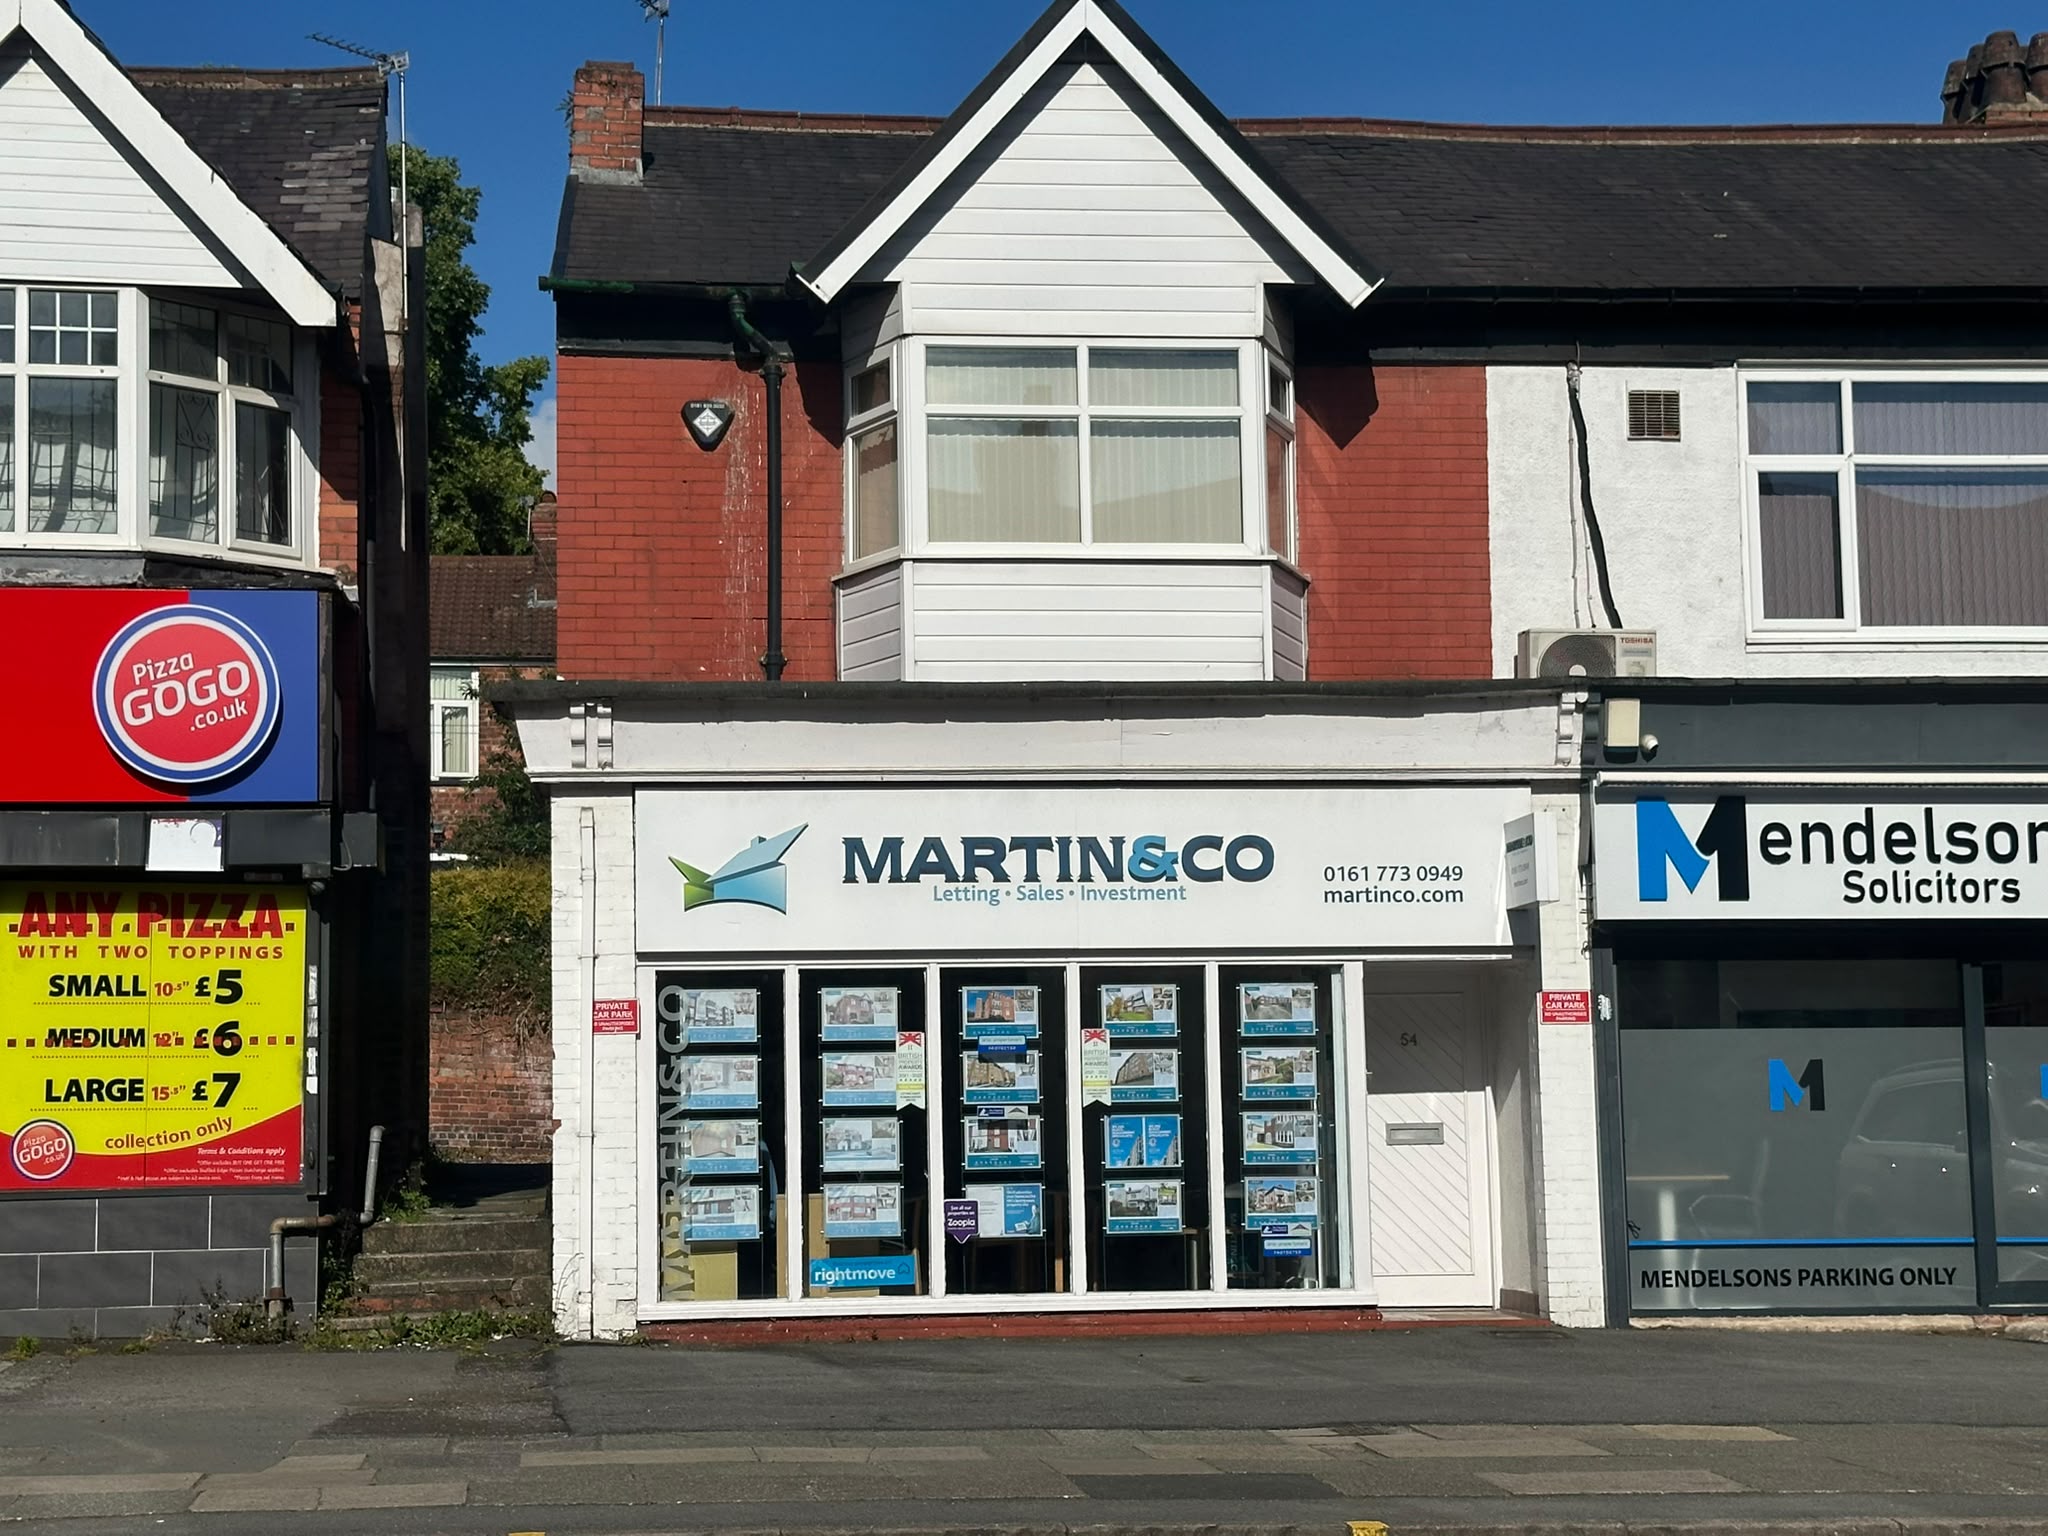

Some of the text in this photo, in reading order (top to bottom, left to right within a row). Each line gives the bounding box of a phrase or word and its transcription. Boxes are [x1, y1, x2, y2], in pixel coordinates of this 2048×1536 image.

[133, 652, 194, 685] Pizza
[122, 660, 251, 727] GOGO
[190, 698, 248, 732] .co.uk
[841, 834, 1276, 884] MARTIN&CO
[1324, 866, 1463, 882] 0161 773 0949
[1842, 870, 2021, 903] Solicitors
[933, 885, 1187, 907] Letting Sales Investment
[1324, 885, 1464, 903] martinco.com
[18, 891, 284, 939] ANY PIZZA
[19, 945, 284, 960] WITH TWO TOPPINGS
[48, 974, 147, 997] SMALL
[194, 969, 244, 1005] £5
[47, 1028, 146, 1049] MEDIUM
[193, 1021, 244, 1057] £6
[1400, 1032, 1418, 1047] 54
[45, 1078, 144, 1102] LARGE
[191, 1072, 242, 1108] £7
[1768, 1058, 1826, 1112] M
[23, 1136, 47, 1148] Pizza
[105, 1116, 233, 1149] collection only
[19, 1138, 67, 1164] GOGO
[197, 1147, 218, 1155] Terms
[227, 1147, 264, 1155] Conditions
[265, 1147, 286, 1156] apply
[947, 1219, 975, 1227] Zoopla
[814, 1267, 896, 1285] rightmove
[1640, 1266, 1957, 1289] MENDELSONS PARKING ONLY
